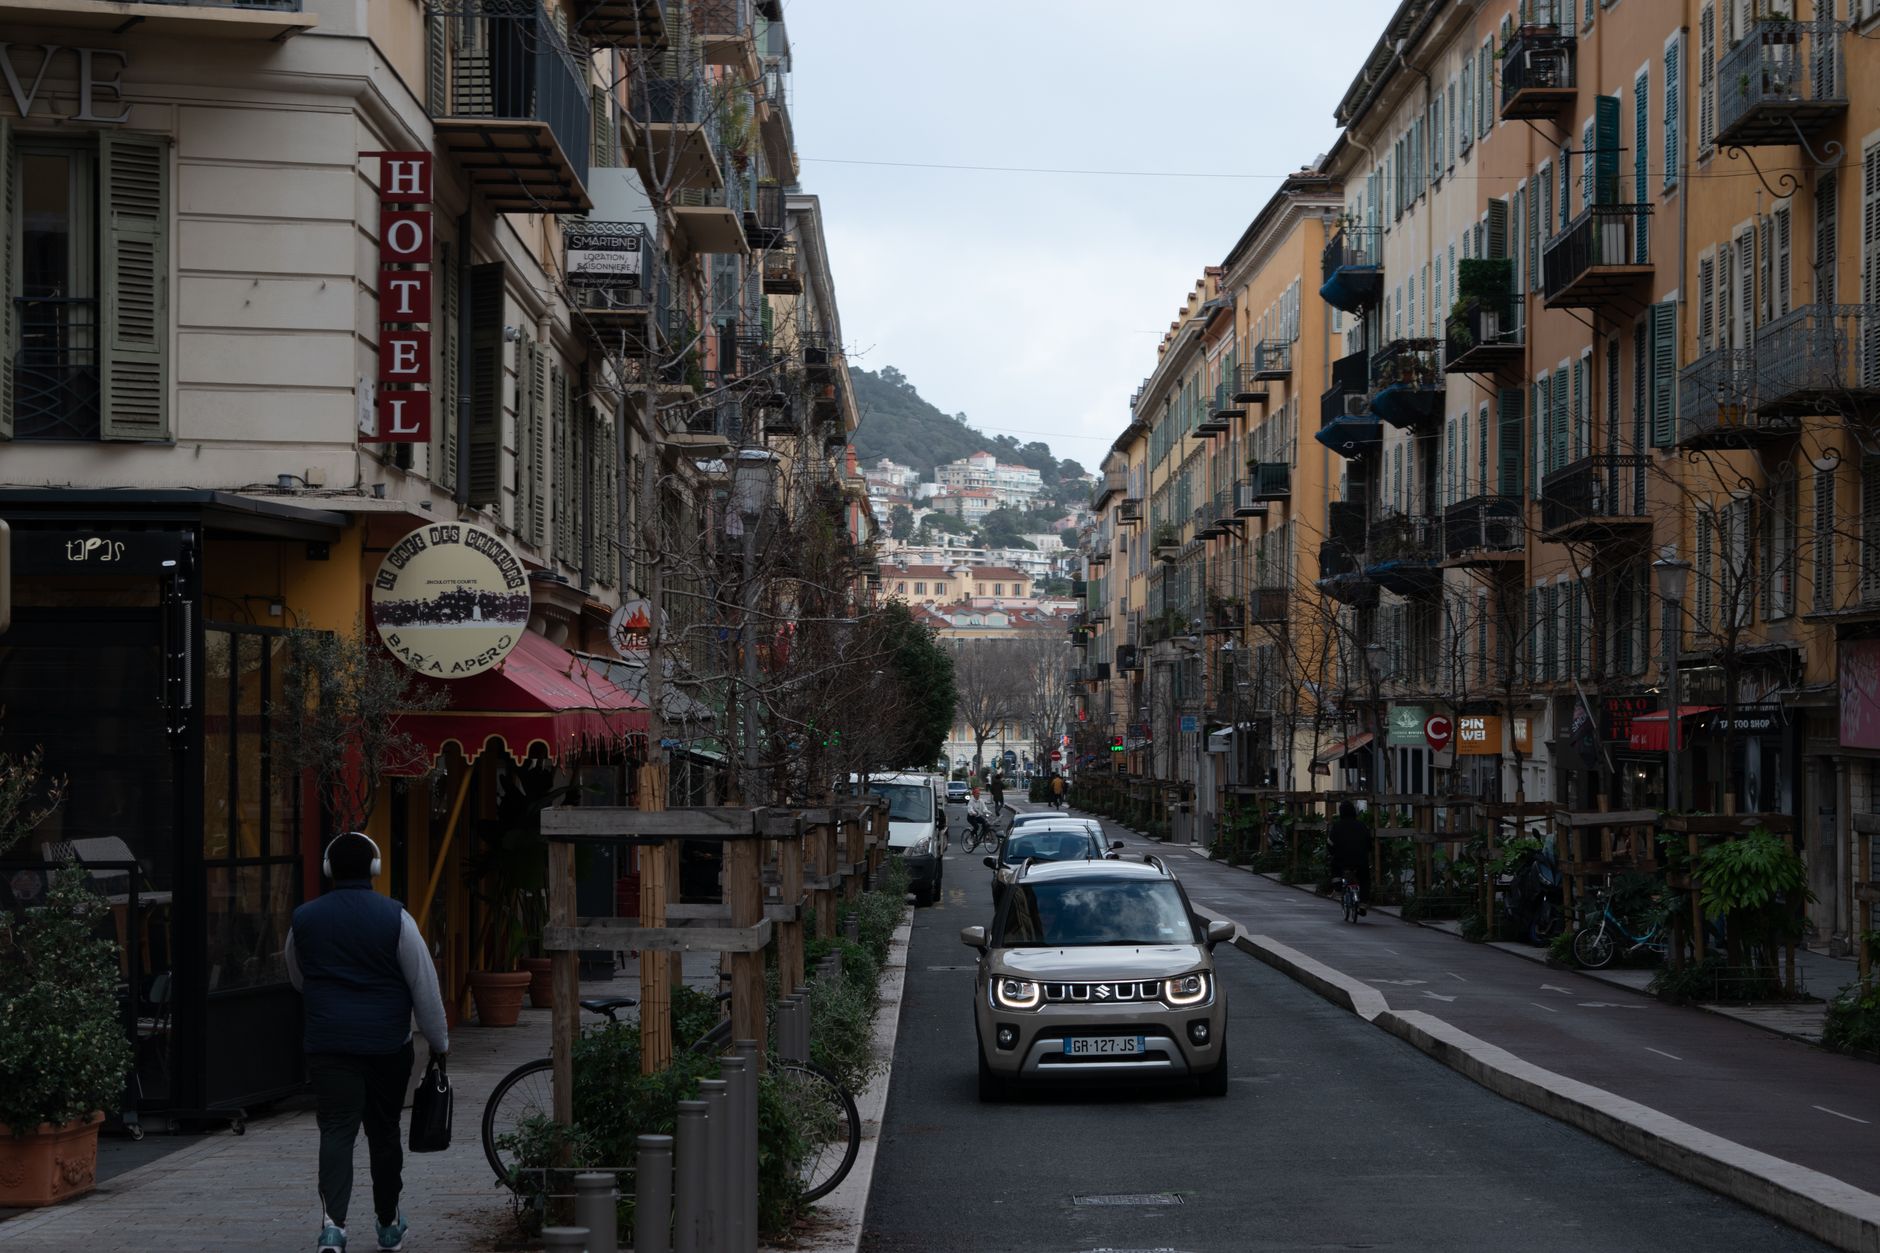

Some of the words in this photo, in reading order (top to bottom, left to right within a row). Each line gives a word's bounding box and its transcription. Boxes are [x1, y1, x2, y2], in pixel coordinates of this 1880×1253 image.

[584, 253, 626, 261] LOCATION
[386, 159, 425, 435] HOTEL
[376, 568, 398, 591] LE
[387, 533, 427, 570] CAFE
[429, 525, 460, 546] DES
[464, 528, 526, 590] CHINEURS
[387, 633, 427, 671] BAR
[450, 635, 512, 673] APERO
[1460, 718, 1484, 730] PIN
[1750, 719, 1770, 729] SHOP
[1460, 729, 1486, 741] WEI
